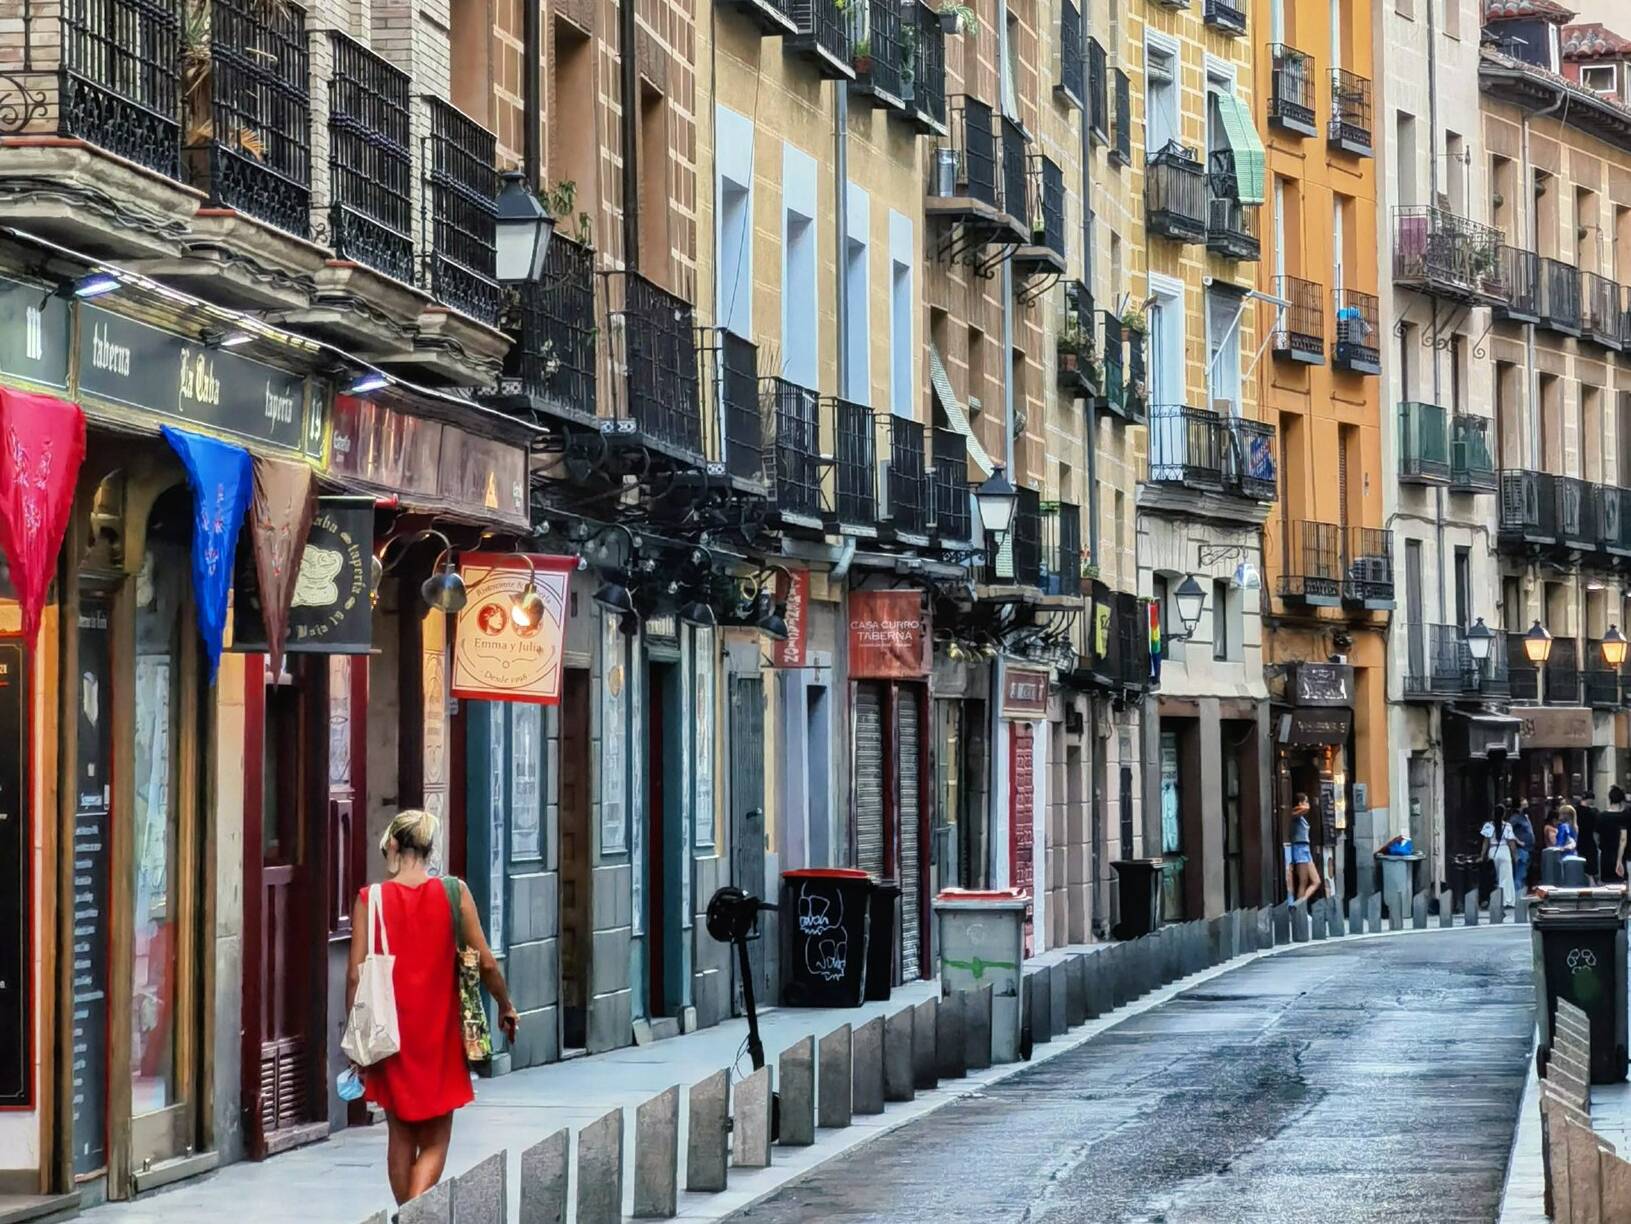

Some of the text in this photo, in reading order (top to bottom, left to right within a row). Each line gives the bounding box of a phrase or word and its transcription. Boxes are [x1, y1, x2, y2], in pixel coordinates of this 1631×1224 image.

[93, 322, 130, 376] taberna
[313, 516, 337, 533] aba
[850, 620, 920, 630] CASA CURRO
[857, 631, 913, 641] TABERNA
[474, 637, 543, 653] Emma y Julia
